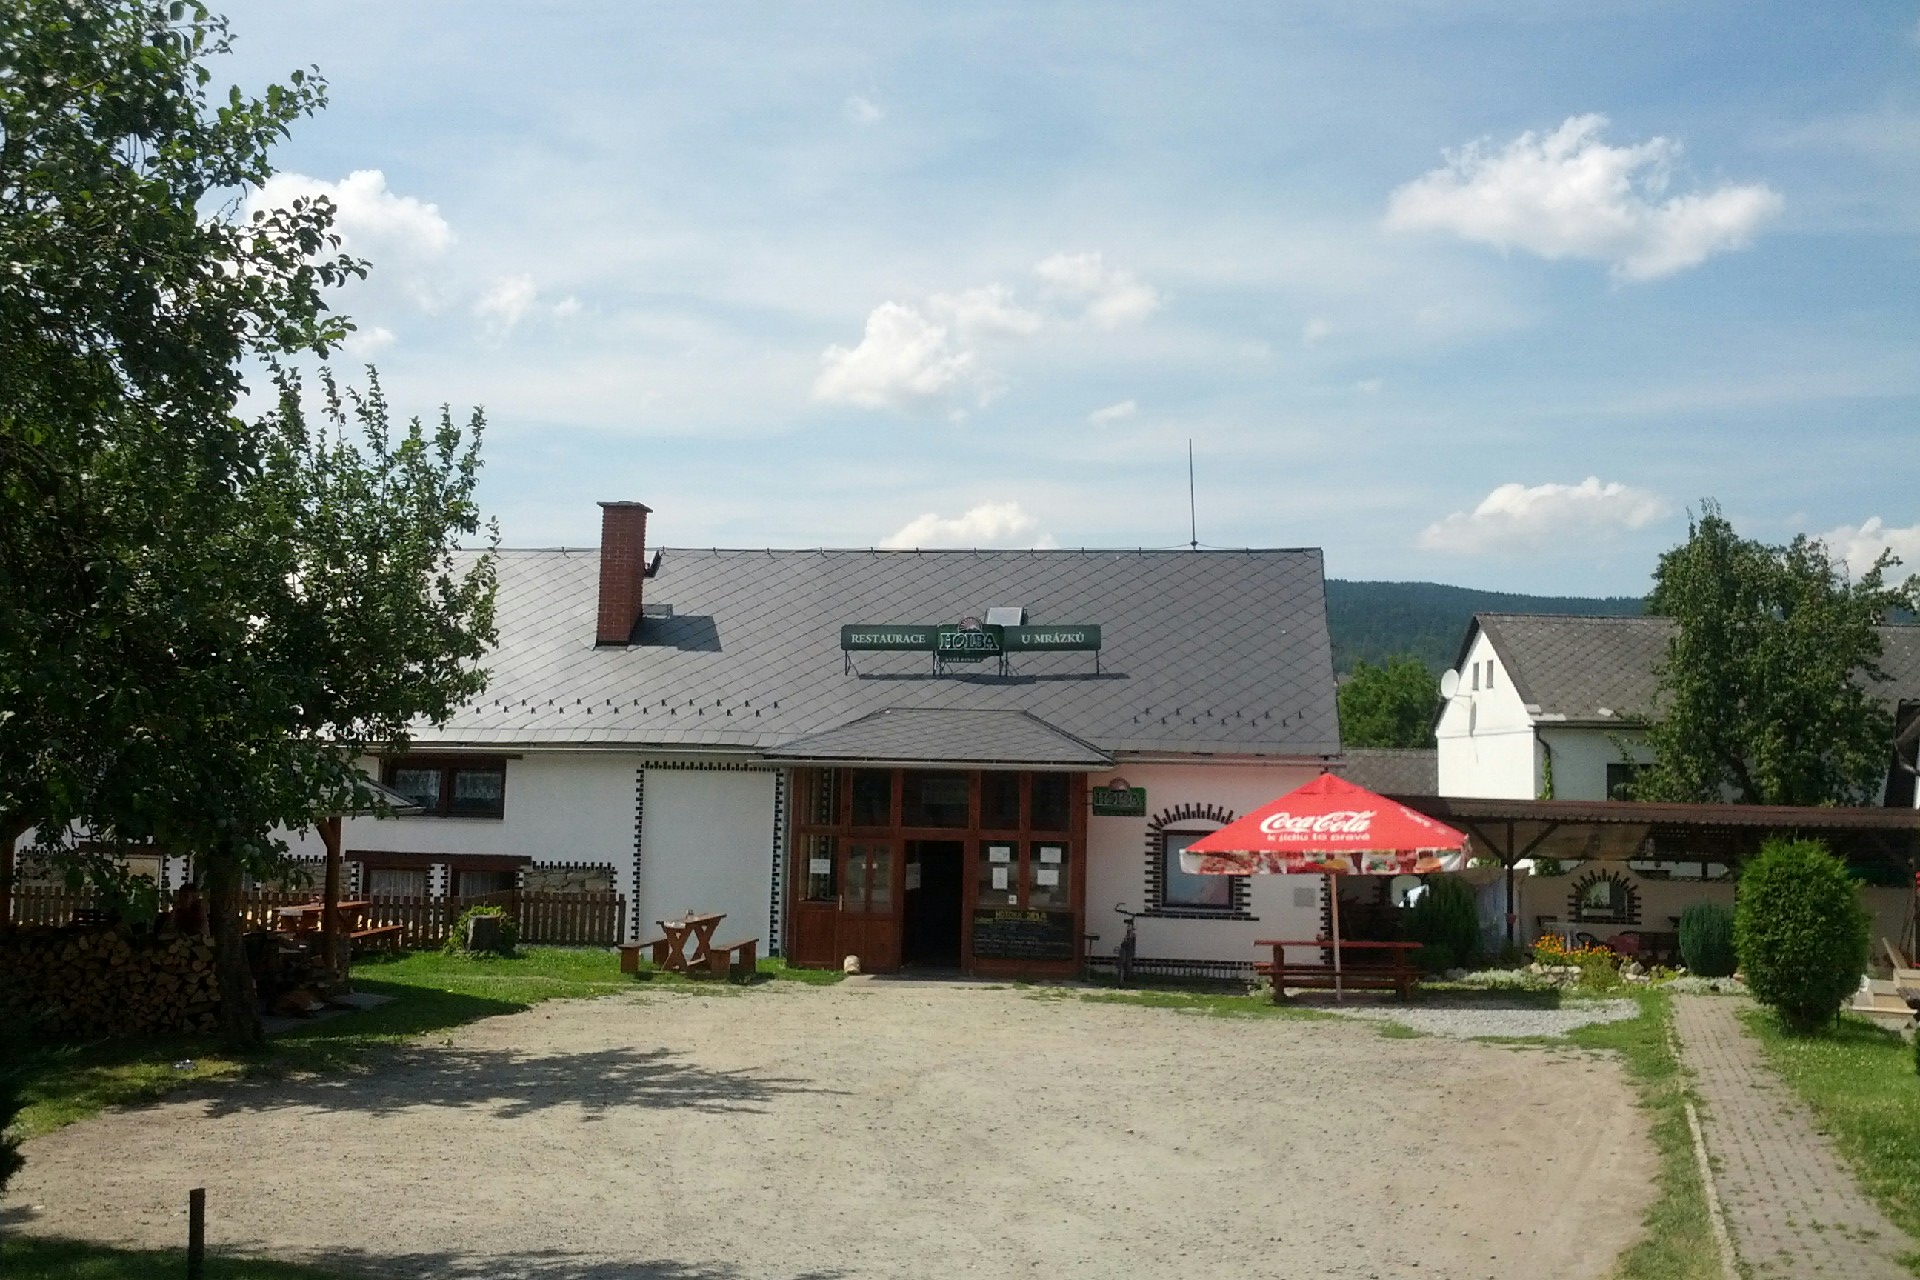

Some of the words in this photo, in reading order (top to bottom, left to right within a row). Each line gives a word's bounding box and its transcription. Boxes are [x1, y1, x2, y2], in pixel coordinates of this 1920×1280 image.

[851, 633, 926, 644] RESTAURACE
[939, 632, 999, 650] HOLBA
[1021, 634, 1031, 645] U
[1034, 632, 1085, 644] MRÁZKŮ
